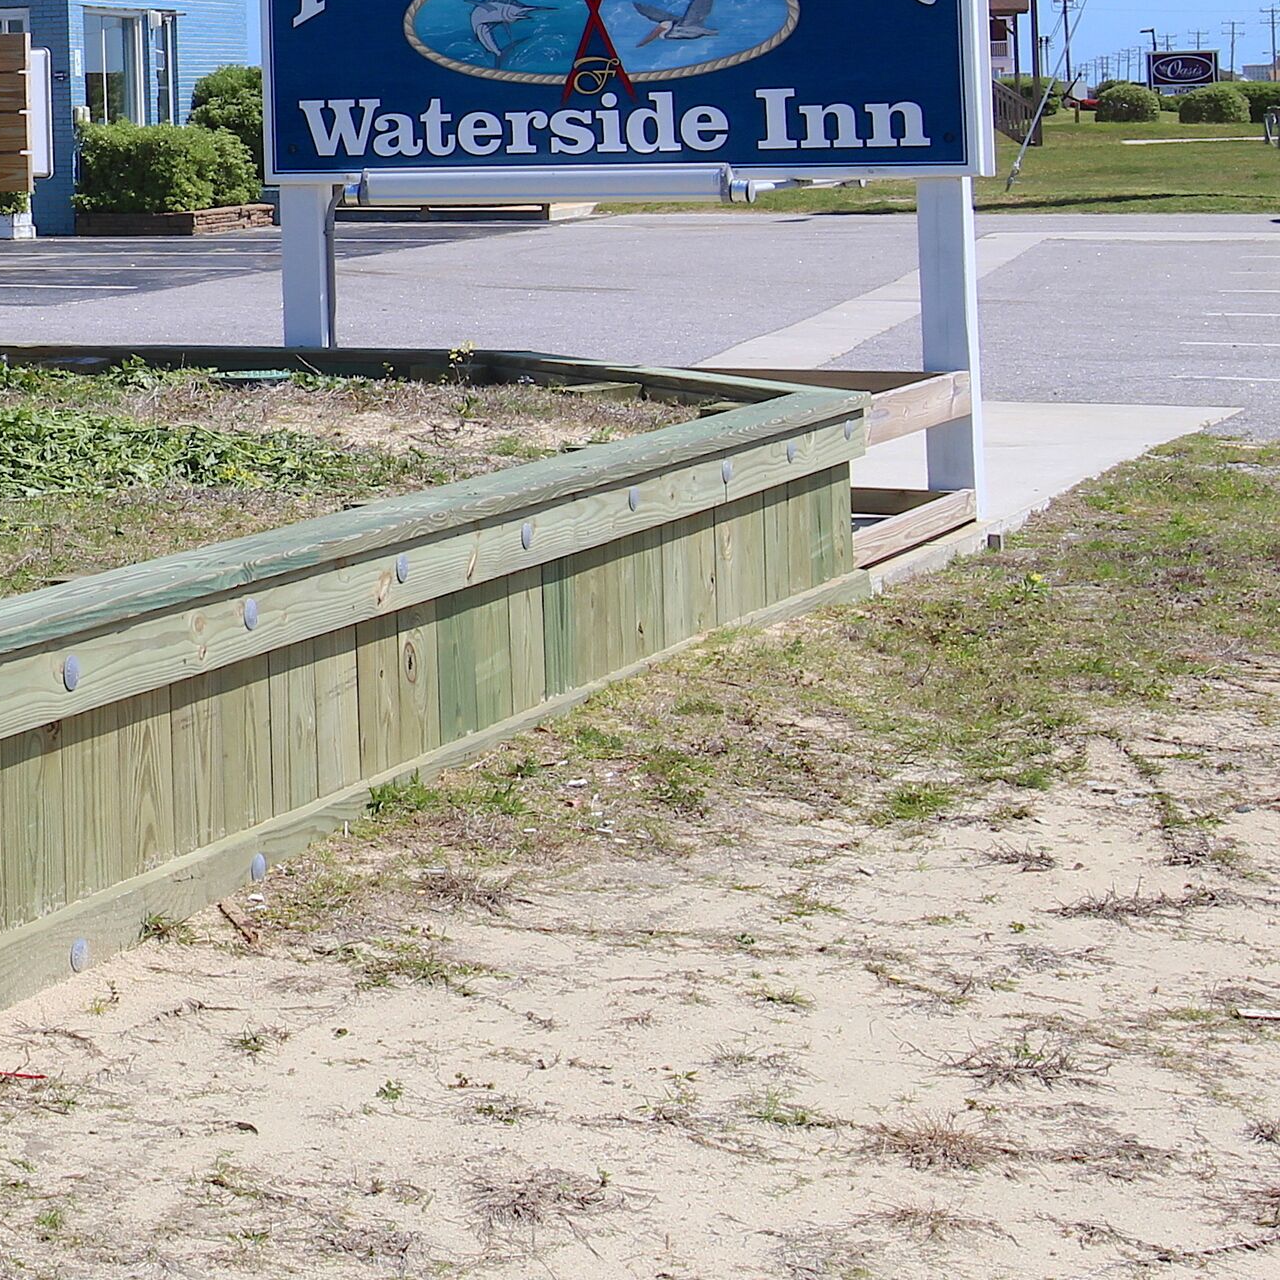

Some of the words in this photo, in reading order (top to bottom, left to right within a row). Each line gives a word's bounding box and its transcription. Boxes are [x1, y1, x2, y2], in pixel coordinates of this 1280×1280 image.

[1167, 59, 1202, 78] Oasis
[299, 92, 730, 157] Waterside
[755, 87, 932, 150] Inn
